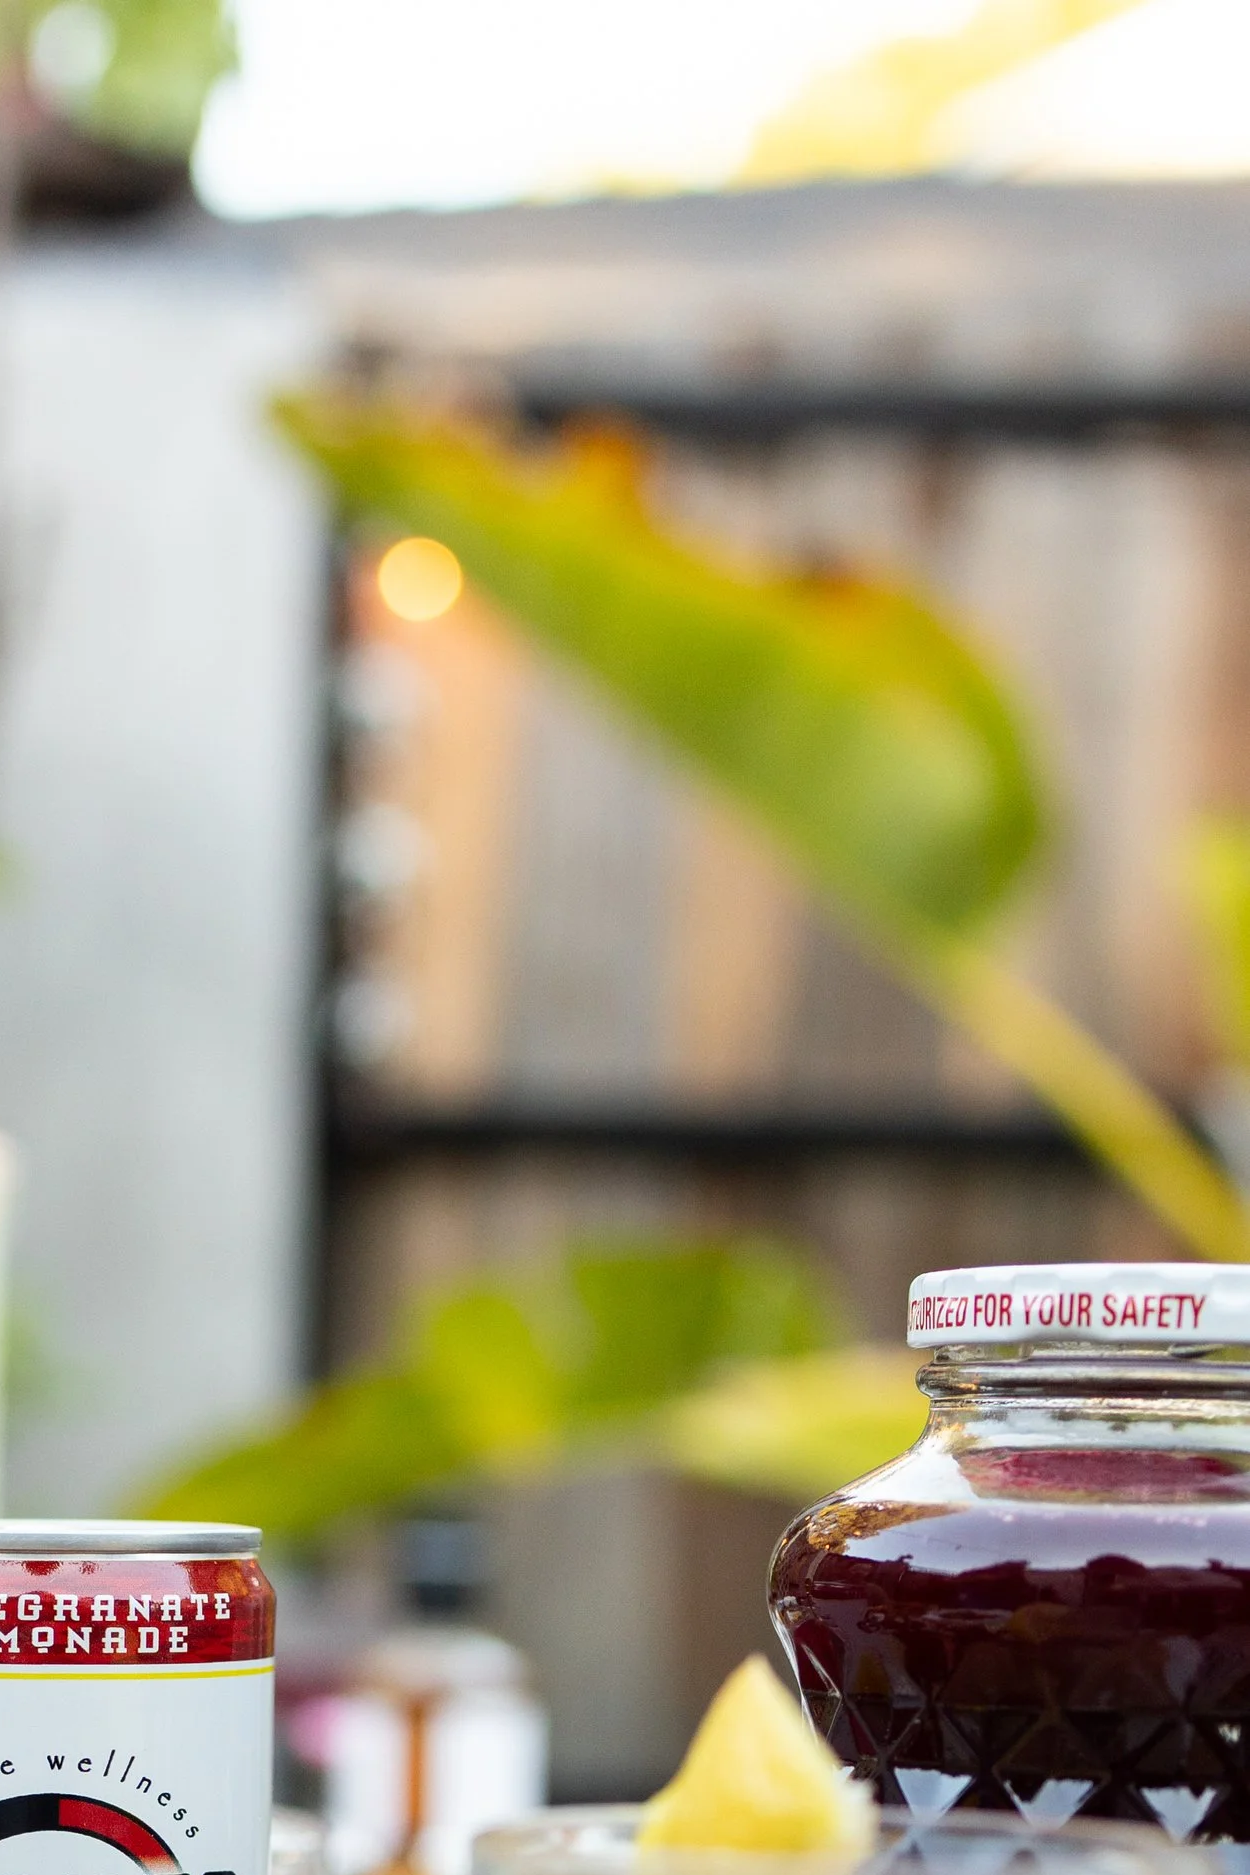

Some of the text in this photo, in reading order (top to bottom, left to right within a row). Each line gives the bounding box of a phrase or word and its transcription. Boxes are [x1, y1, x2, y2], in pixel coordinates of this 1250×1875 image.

[973, 1293, 1012, 1327] FOR
[1023, 1293, 1091, 1327] YOUR
[1102, 1294, 1207, 1329] SAFETY
[47, 1749, 199, 1838] wellness
